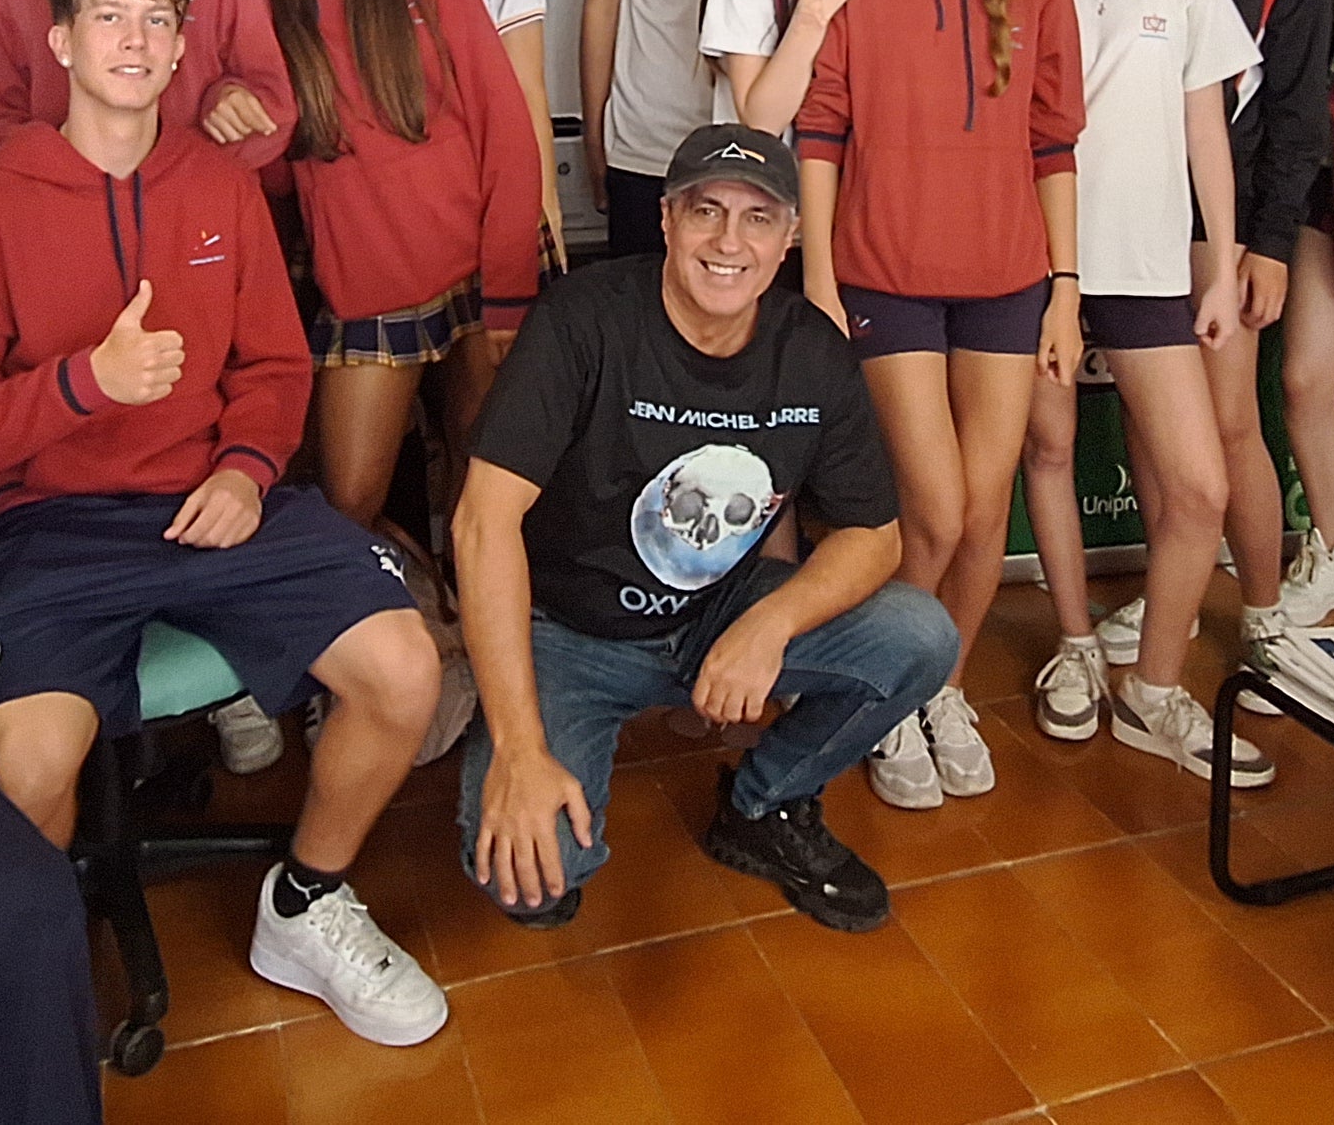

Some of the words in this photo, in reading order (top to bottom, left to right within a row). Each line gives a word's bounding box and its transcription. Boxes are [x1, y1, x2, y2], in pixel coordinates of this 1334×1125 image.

[629, 400, 675, 423] JEAN
[678, 409, 760, 430] MICHEL
[619, 585, 690, 615] OXY
